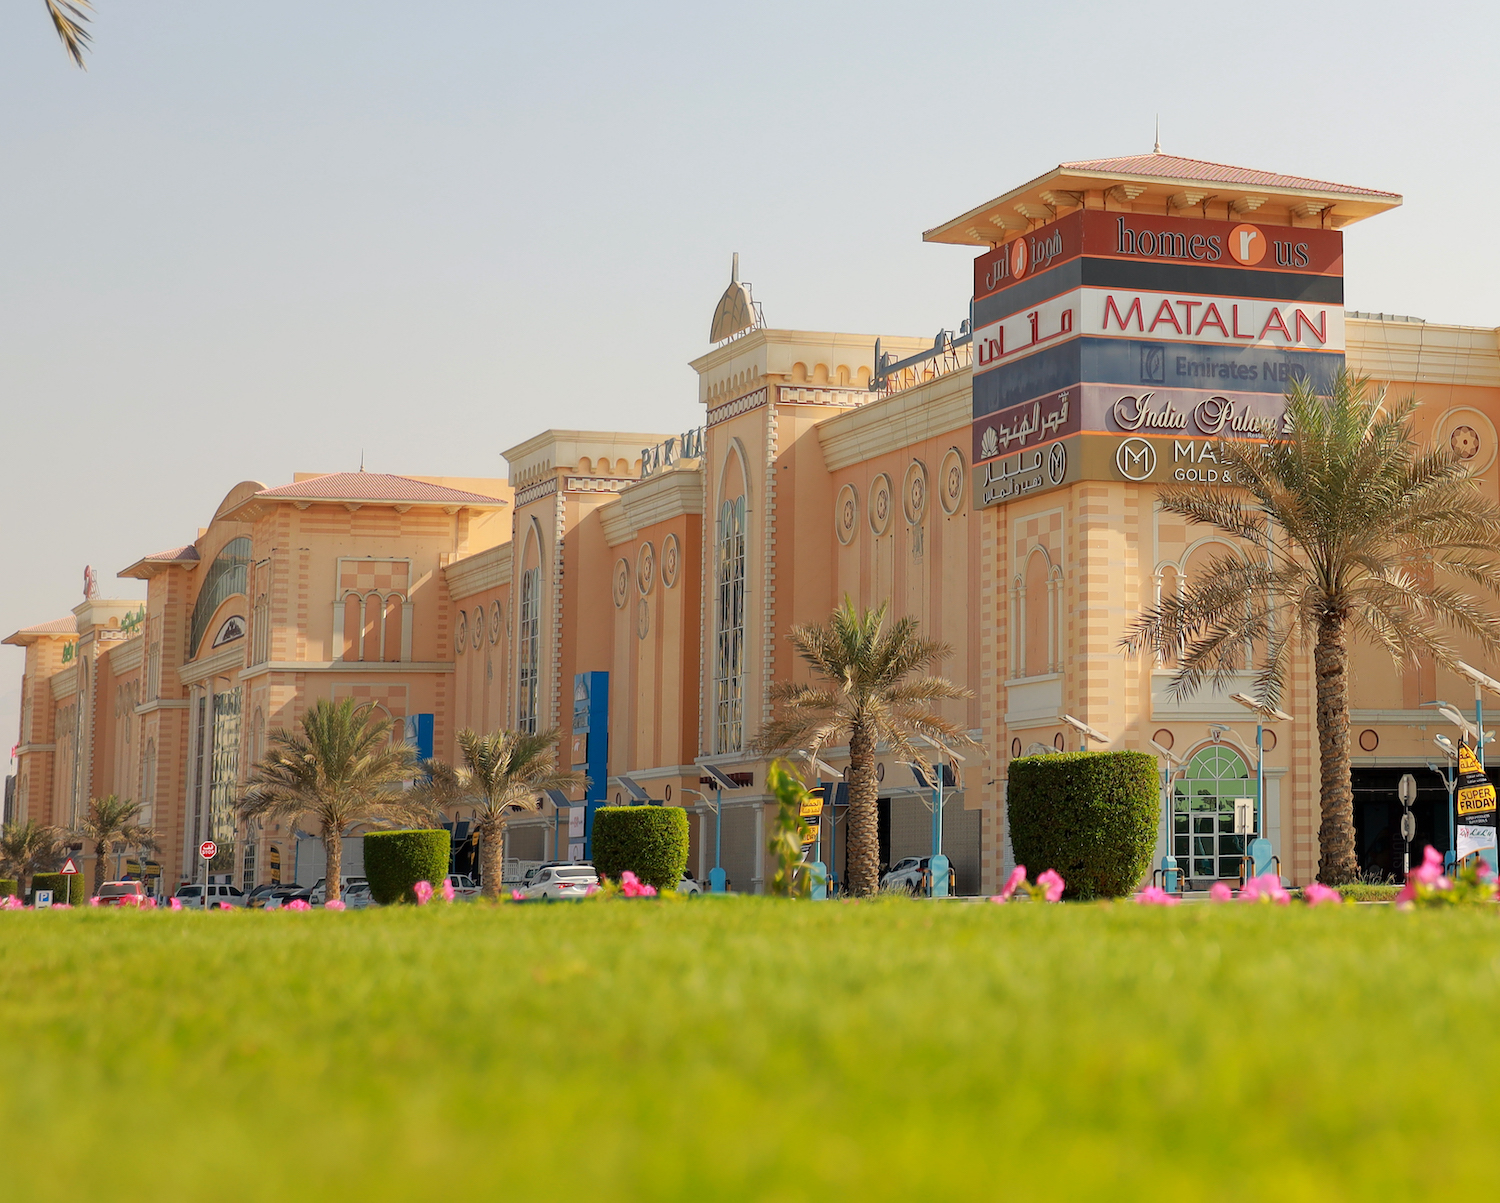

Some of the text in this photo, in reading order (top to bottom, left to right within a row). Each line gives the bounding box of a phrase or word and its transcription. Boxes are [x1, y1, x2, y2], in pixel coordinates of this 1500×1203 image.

[1117, 216, 1222, 261] homes
[1273, 239, 1310, 268] us
[1103, 295, 1327, 344] MATALAN
[1176, 356, 1306, 383] Emirates NBD
[1113, 392, 1189, 431] India
[641, 426, 705, 479] RAK MA
[1174, 468, 1218, 482] GOLD
[1221, 470, 1232, 483] &
[1460, 788, 1491, 801] SUPER
[1460, 797, 1496, 811] FRIDAY
